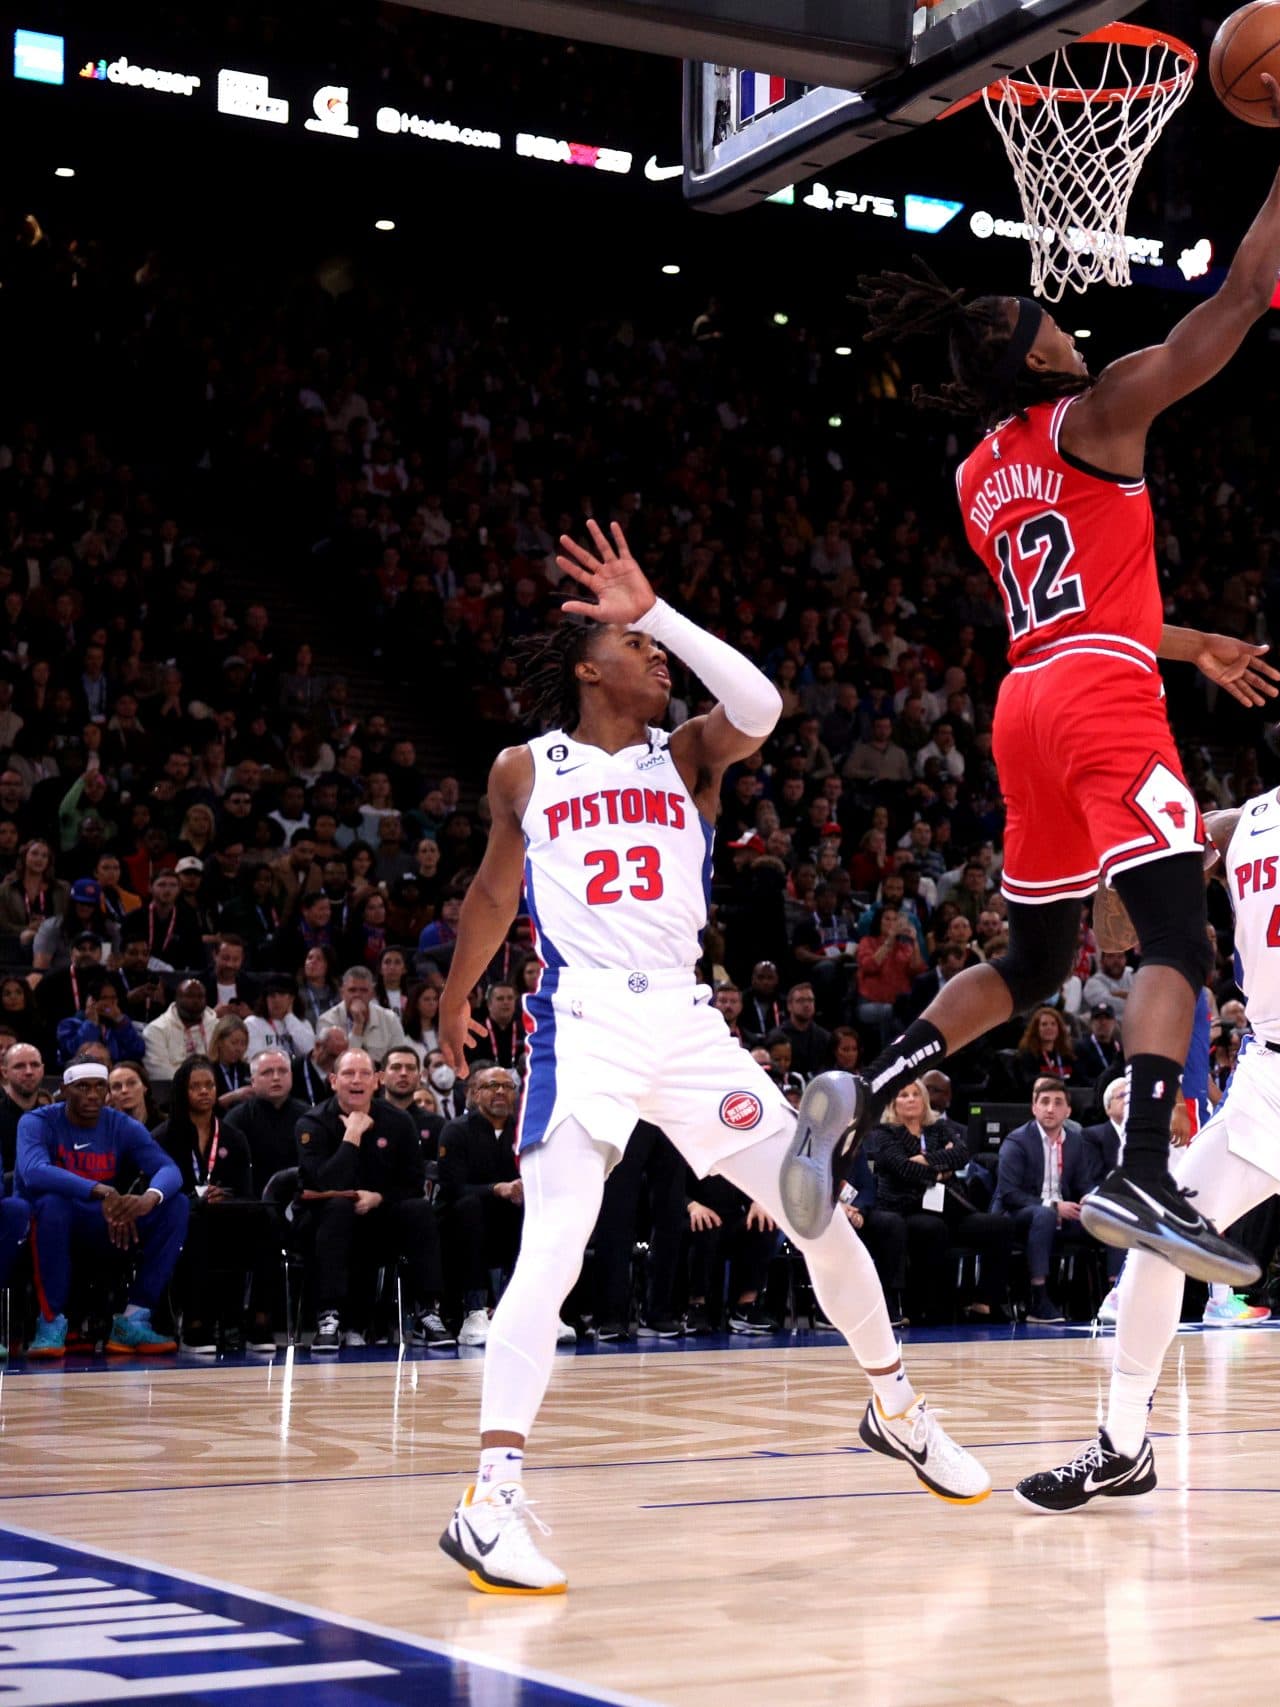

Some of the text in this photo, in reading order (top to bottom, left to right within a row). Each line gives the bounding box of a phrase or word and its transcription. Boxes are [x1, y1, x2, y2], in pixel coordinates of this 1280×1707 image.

[970, 464, 1064, 535] DOSUNMU
[994, 510, 1086, 641] 12
[551, 745, 565, 760] 6
[543, 788, 685, 841] PISTONS
[584, 845, 664, 905] 23
